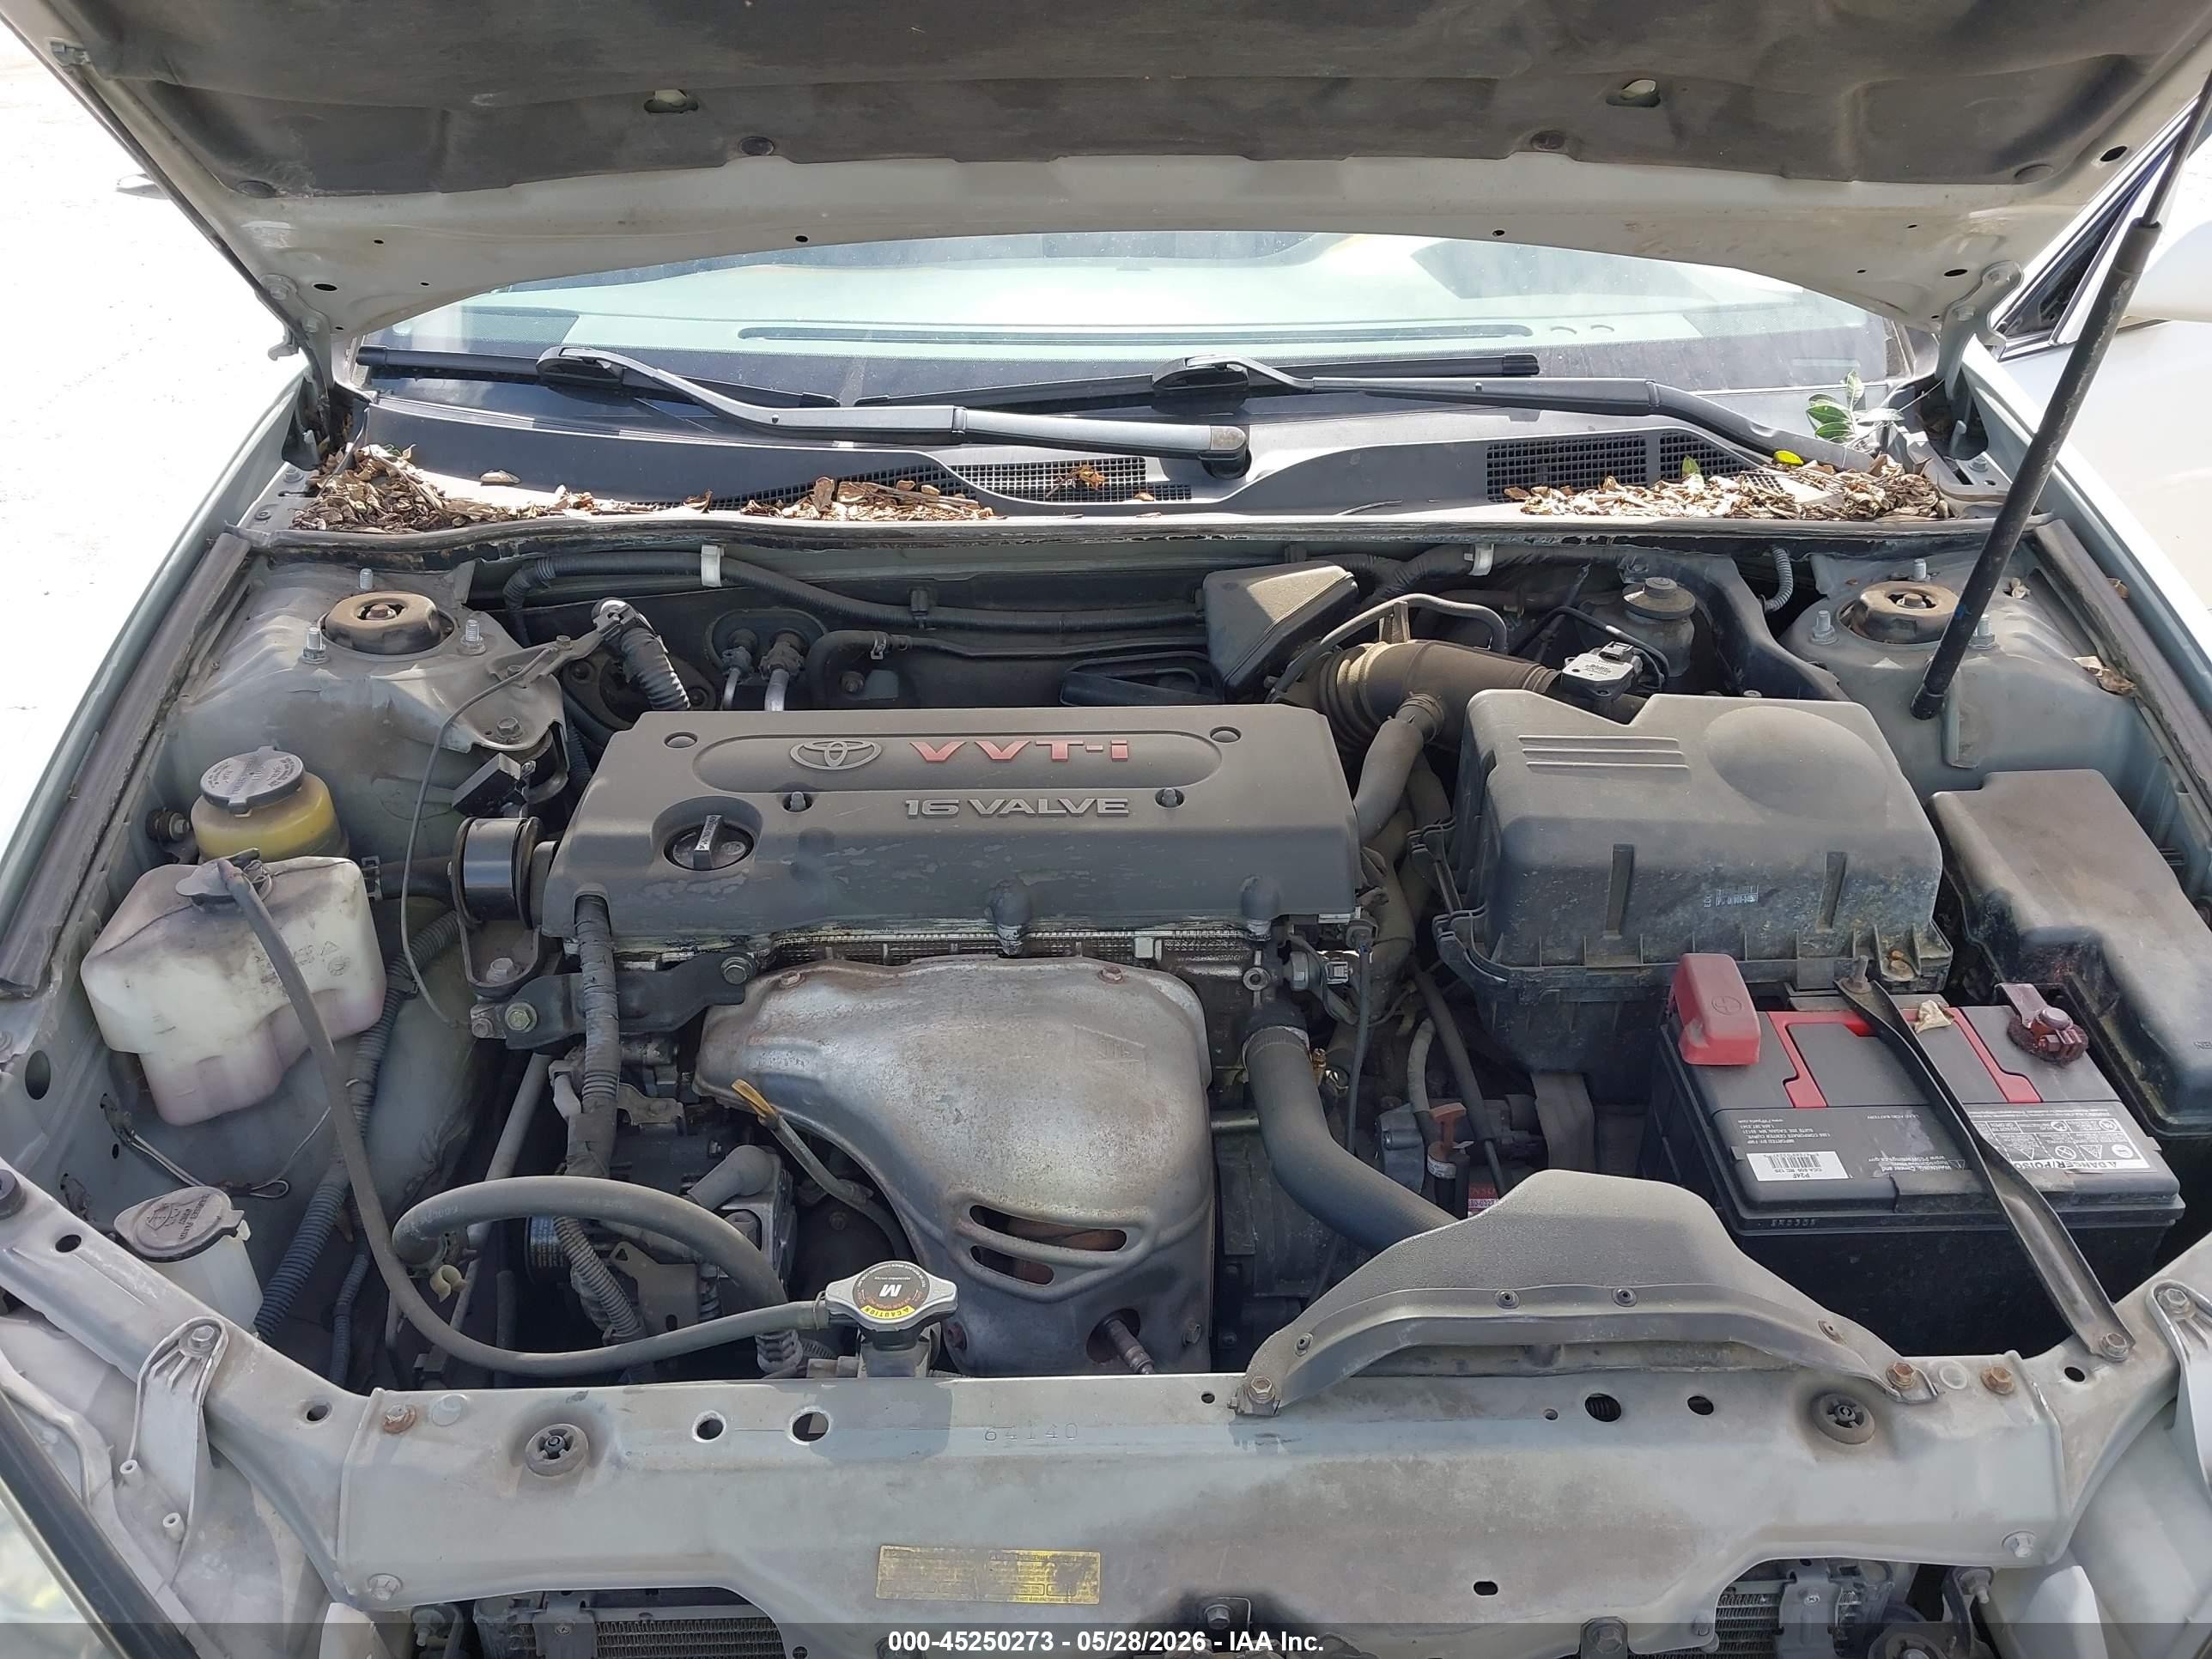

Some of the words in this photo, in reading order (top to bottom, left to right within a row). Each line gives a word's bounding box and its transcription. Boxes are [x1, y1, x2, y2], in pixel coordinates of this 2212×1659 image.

[909, 739, 1129, 763] VVT-i
[905, 798, 961, 817] 16
[969, 798, 1131, 819] VALVE
[2013, 1160, 2106, 1169] DANGER/POISO
[878, 1284, 902, 1297] M
[864, 1307, 902, 1317] CAUTION
